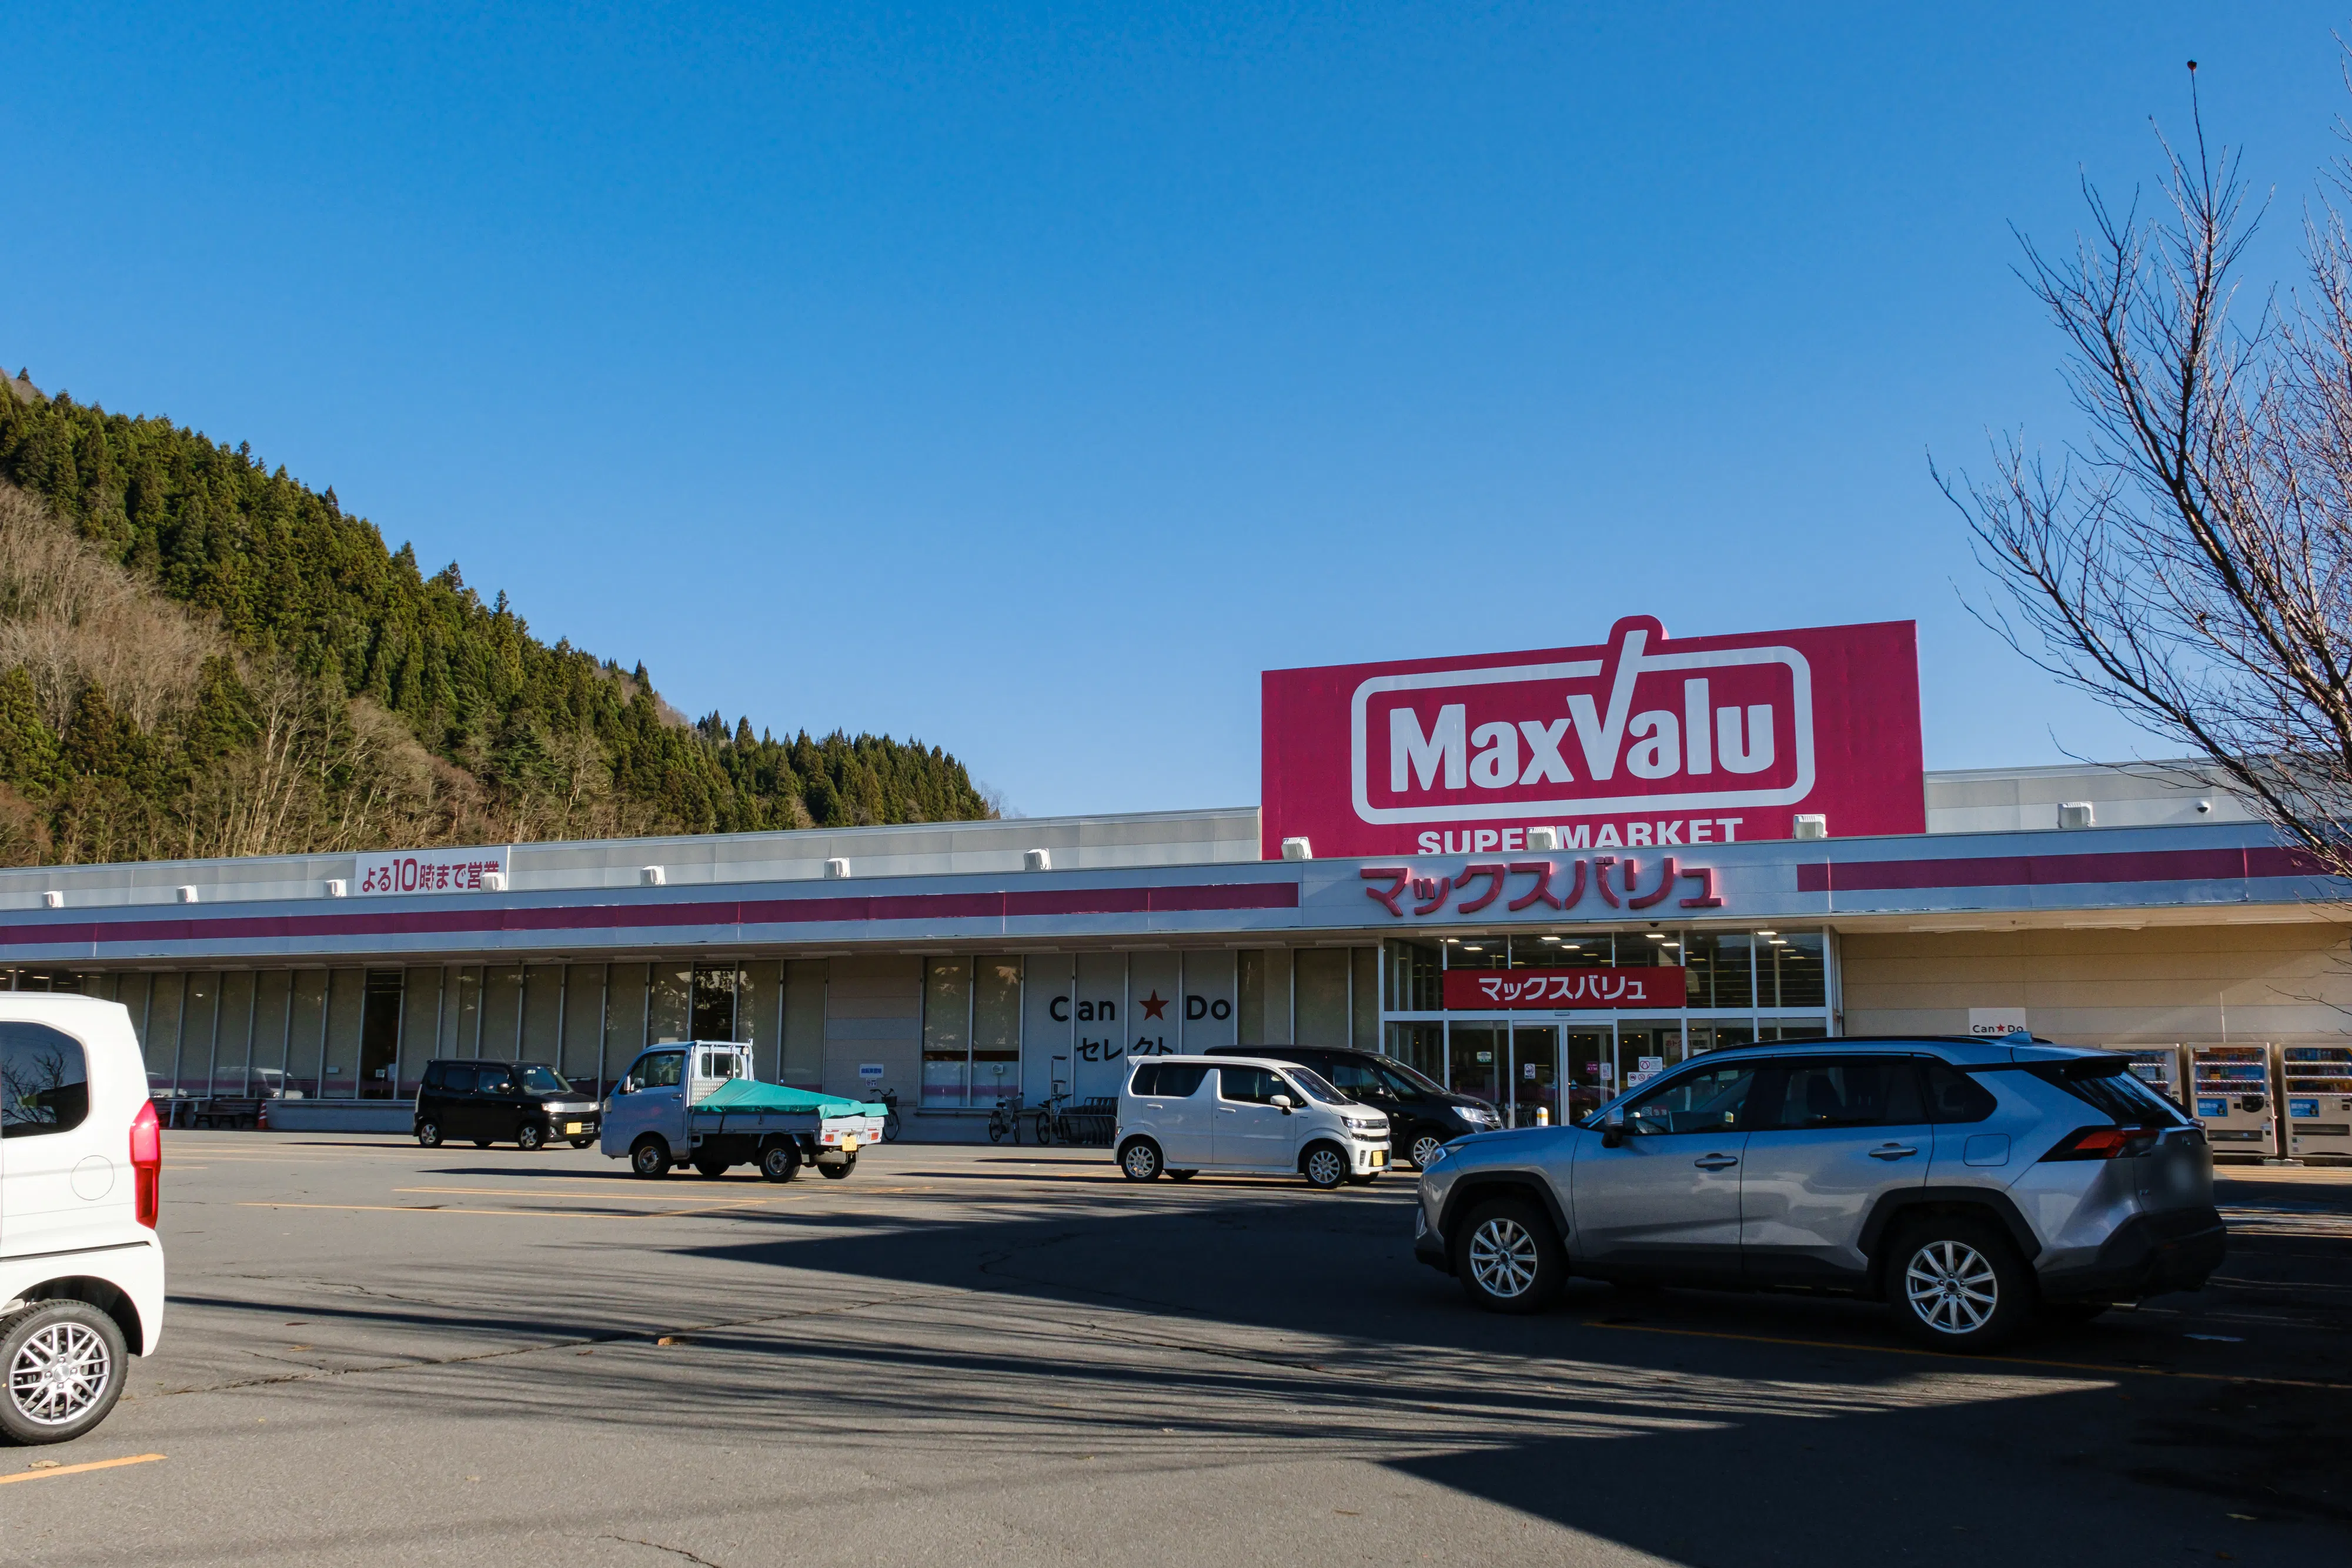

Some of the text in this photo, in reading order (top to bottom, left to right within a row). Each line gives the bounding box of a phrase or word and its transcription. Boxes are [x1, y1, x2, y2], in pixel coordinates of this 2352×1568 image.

[1389, 630, 1775, 793] MaxValu
[1418, 818, 1743, 855] SUPEMARKET
[1360, 856, 1723, 917] マックスバリュ
[1479, 975, 1646, 1001] マックスバリュ
[1050, 995, 1231, 1022] Can Do
[1972, 1025, 1994, 1033] Can
[1077, 1037, 1174, 1062] セレクト
